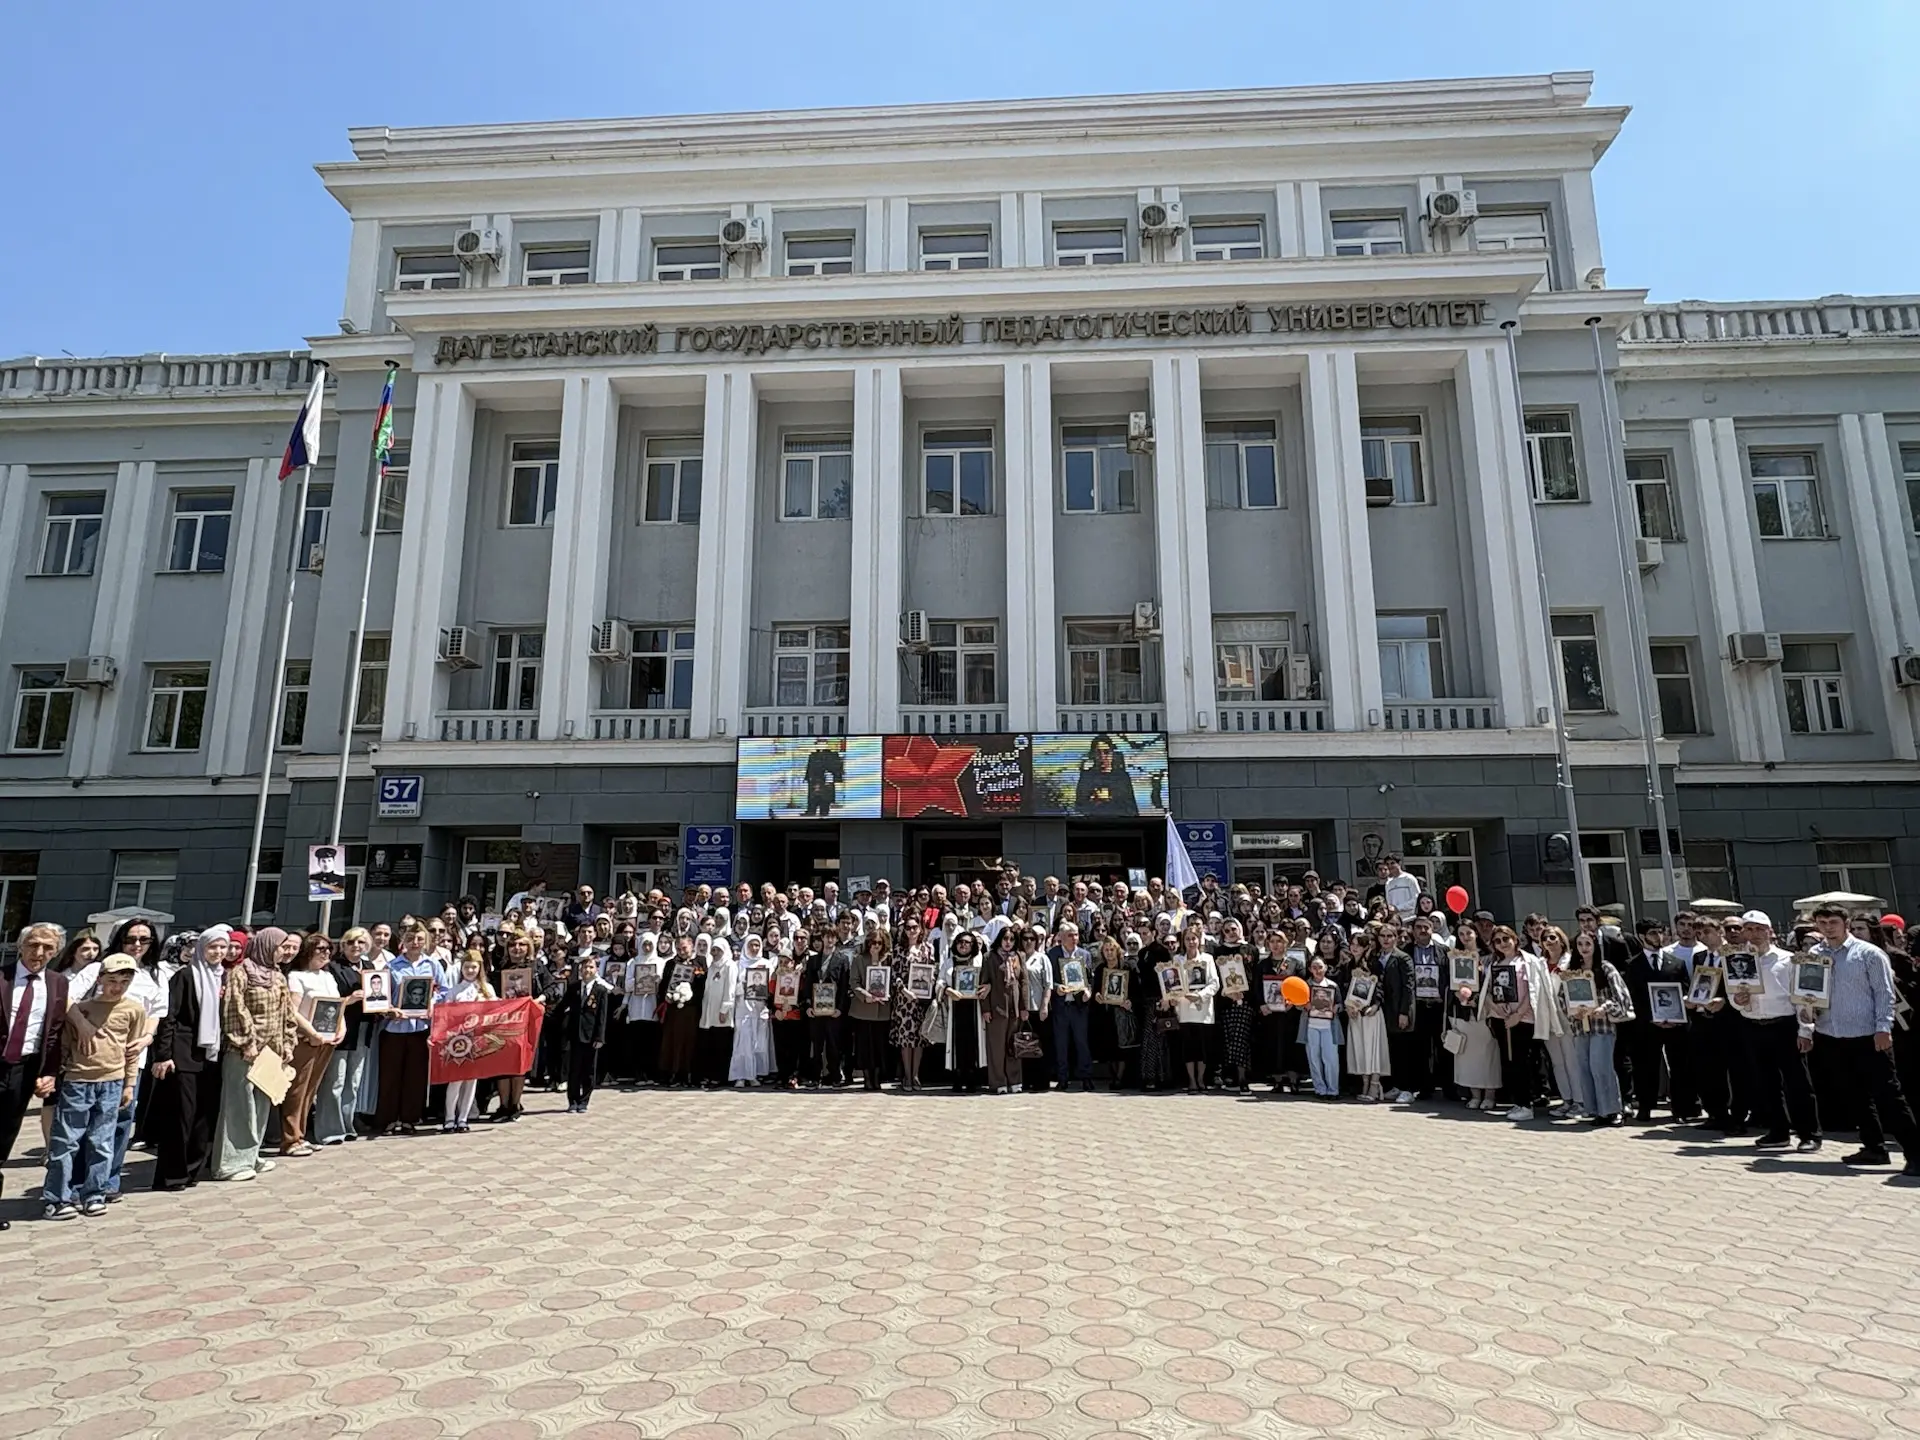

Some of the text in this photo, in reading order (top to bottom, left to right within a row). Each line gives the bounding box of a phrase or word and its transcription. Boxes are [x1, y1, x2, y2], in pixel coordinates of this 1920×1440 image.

[434, 299, 1486, 365] ДАГЕСТАНСКИЙ ГОСУДАРСТВЕННЫЙ ПЕДАГОГИЧЕСКИЙ УНИВЕРСИТЕТ
[383, 779, 417, 800] 57
